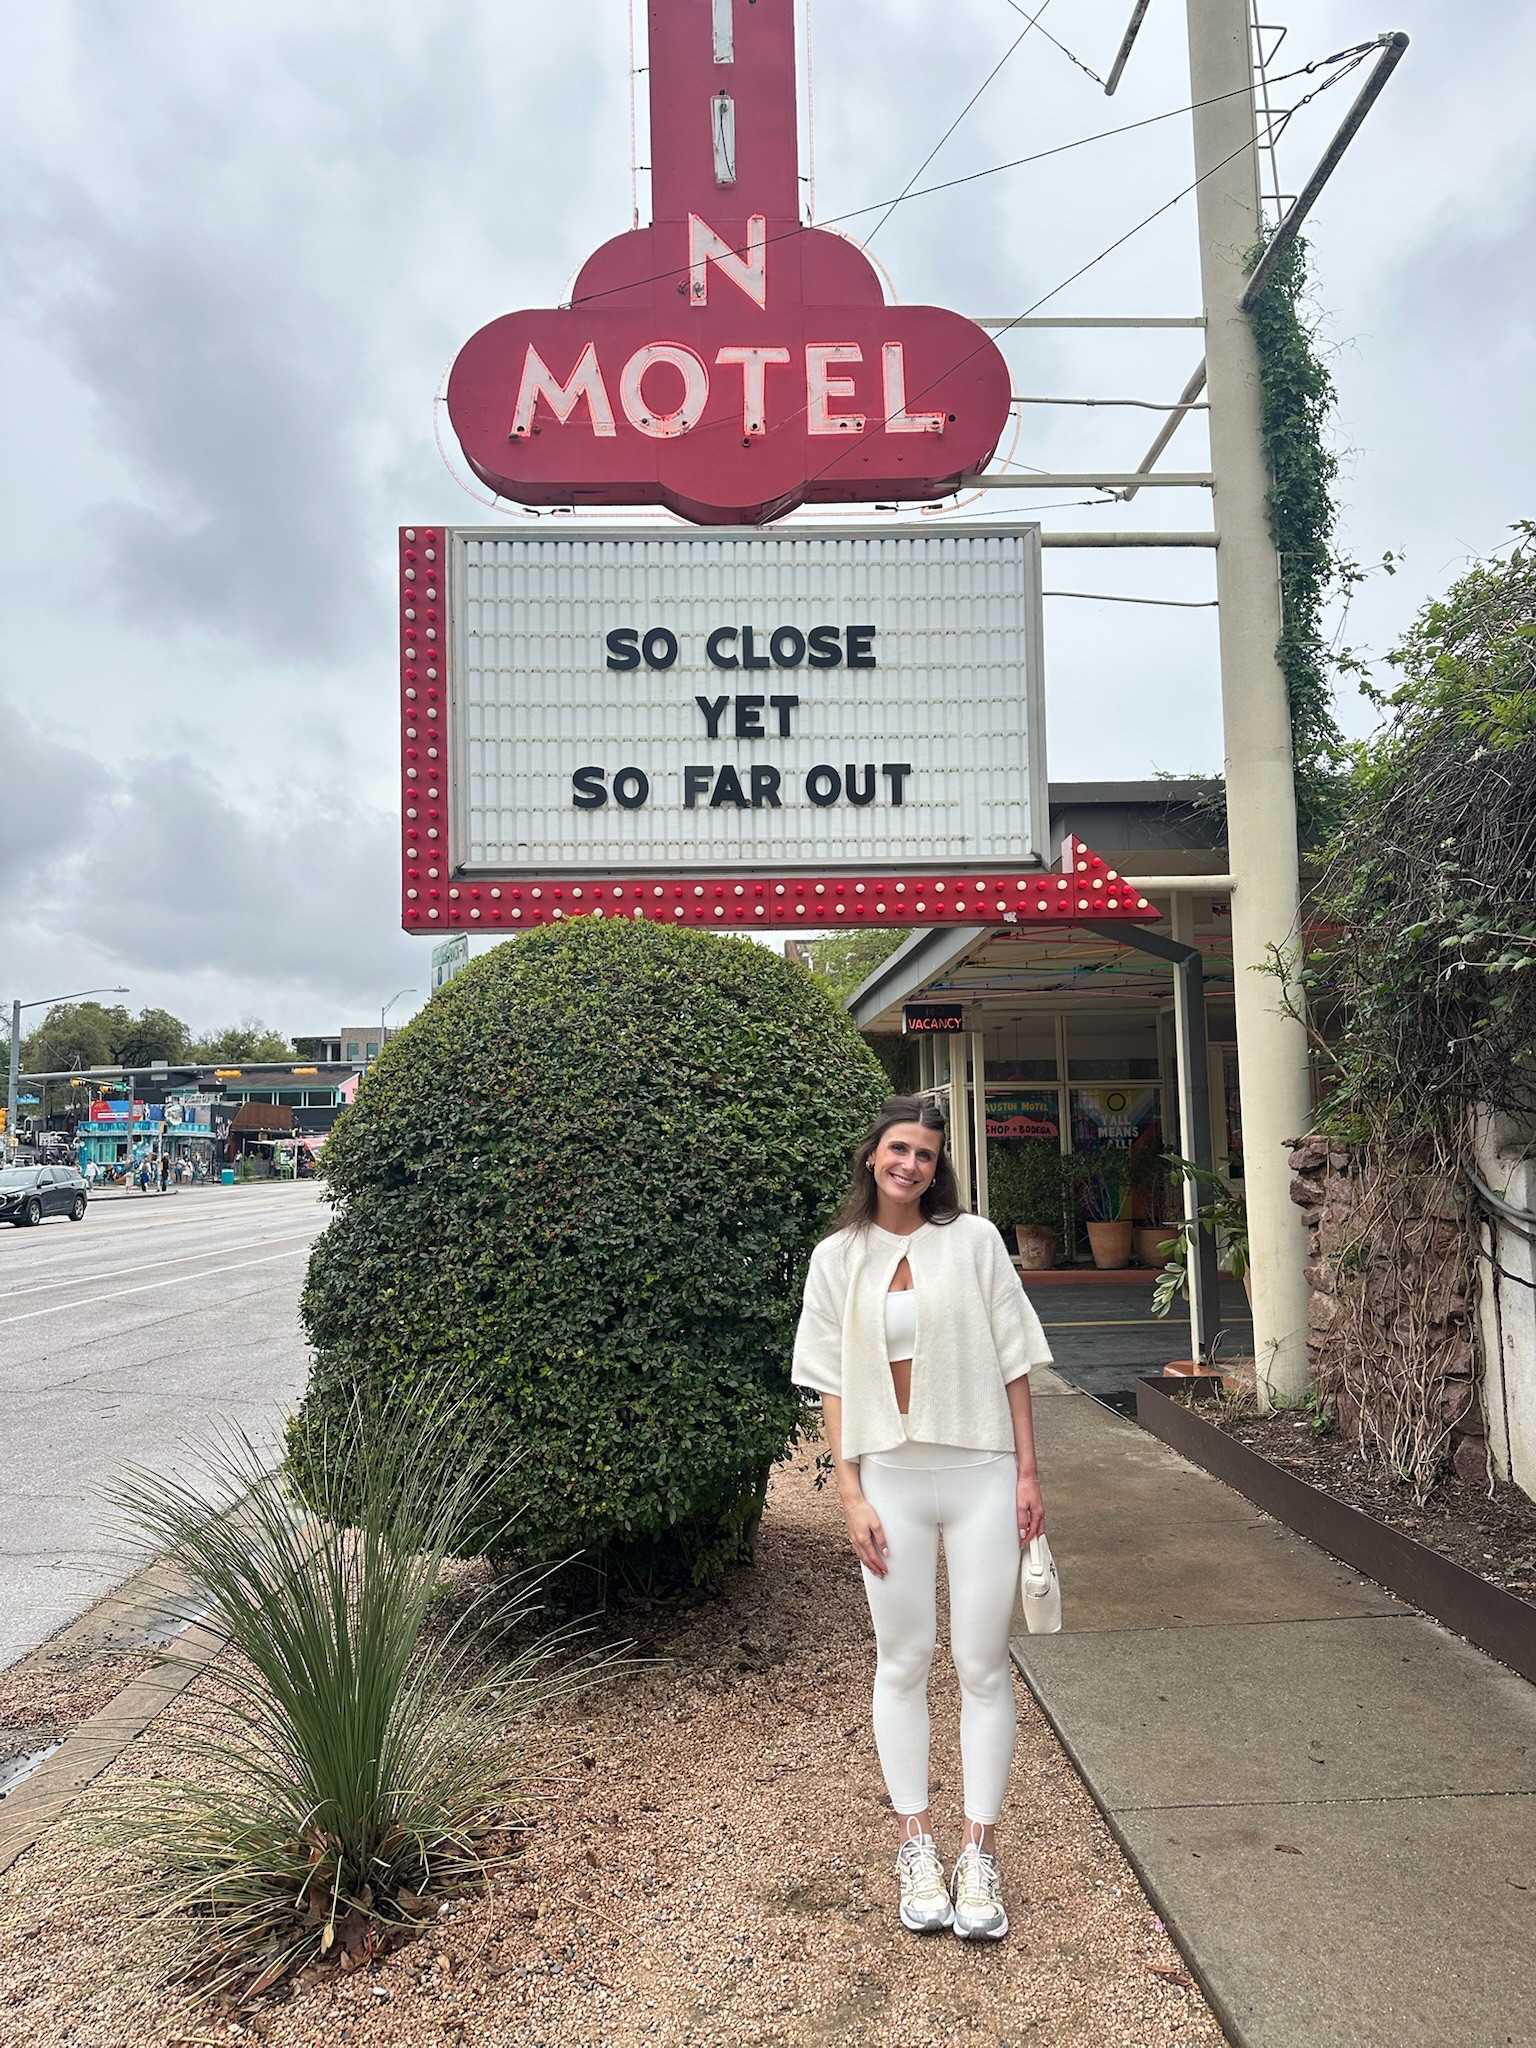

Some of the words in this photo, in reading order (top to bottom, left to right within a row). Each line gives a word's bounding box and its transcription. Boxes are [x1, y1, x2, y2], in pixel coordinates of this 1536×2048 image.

[510, 341, 946, 438] MOTEL
[606, 627, 678, 670] SO
[706, 625, 876, 669] CLOSE
[695, 695, 799, 738] YET
[572, 766, 649, 808] SO
[684, 765, 782, 808] FAR
[806, 764, 911, 806] OUT
[908, 1017, 962, 1030] VACANCY
[985, 1102, 1018, 1112] AUSTIN
[1021, 1101, 1049, 1111] MOTEL
[985, 1125, 1010, 1134] SHOP
[1019, 1125, 1051, 1135] BODEGA
[1097, 1126, 1139, 1138] MEANS
